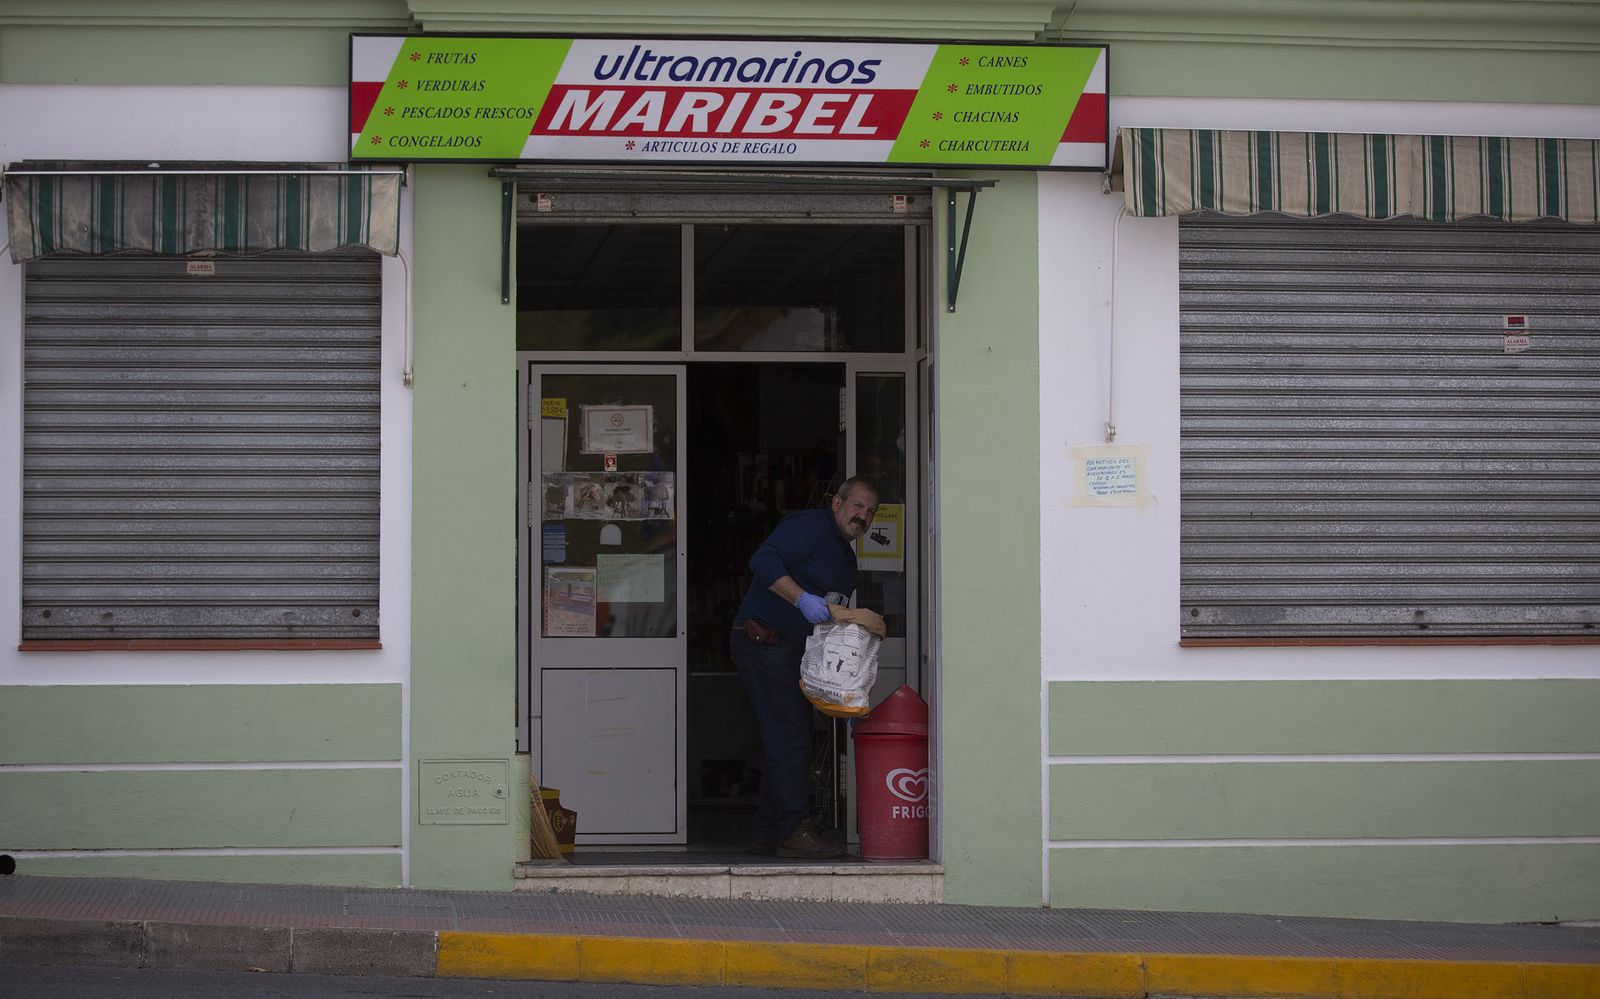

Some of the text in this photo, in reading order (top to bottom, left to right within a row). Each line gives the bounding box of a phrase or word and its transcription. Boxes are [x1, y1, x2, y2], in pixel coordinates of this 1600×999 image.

[426, 52, 478, 65] FRUTAS
[594, 45, 882, 85] ultramarinos
[977, 55, 1029, 69] CARNES
[416, 79, 486, 92] VERDURAS
[965, 83, 1043, 97] EMBUTIDOS
[401, 106, 534, 121] PESCADOS FRESCOS
[547, 89, 879, 136] MARIBEL
[953, 110, 1020, 124] CHACINAS
[388, 135, 483, 148] CONGELADOS
[641, 140, 798, 155] ARTICULOS DE REGALO
[938, 138, 1030, 152] CHARCUTERIA
[434, 768, 492, 786] CONTADOR
[447, 789, 480, 798] AGUA
[426, 807, 488, 815] LLAVE DE PASO
